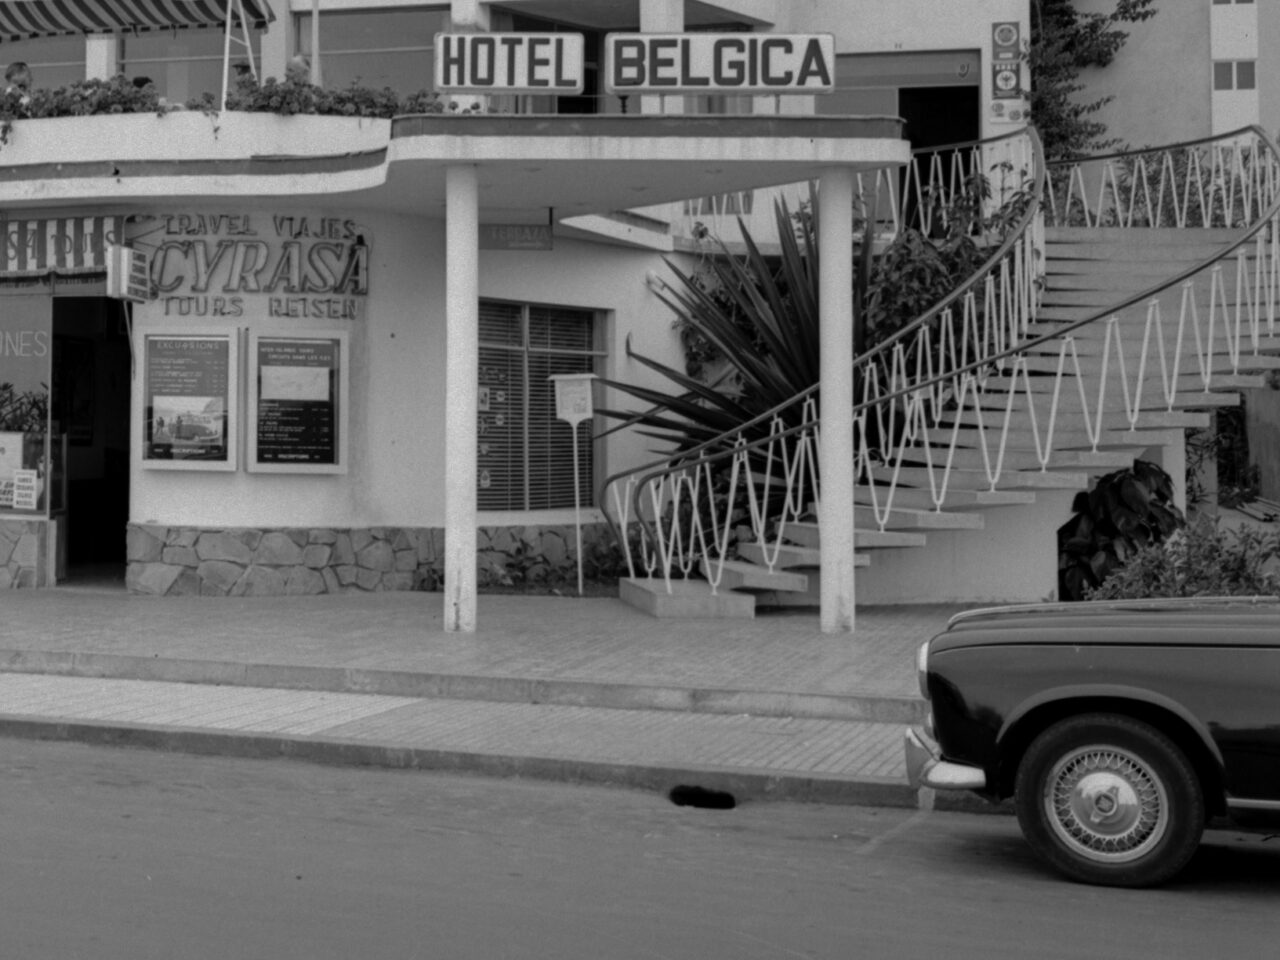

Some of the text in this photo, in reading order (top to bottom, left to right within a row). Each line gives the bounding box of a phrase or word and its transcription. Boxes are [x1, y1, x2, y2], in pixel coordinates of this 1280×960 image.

[442, 36, 832, 88] HOTEL BELGICA
[161, 214, 358, 239] TRAVEL VIAJES
[150, 238, 369, 296] CYRASA
[161, 295, 357, 320] TOURS REISEN
